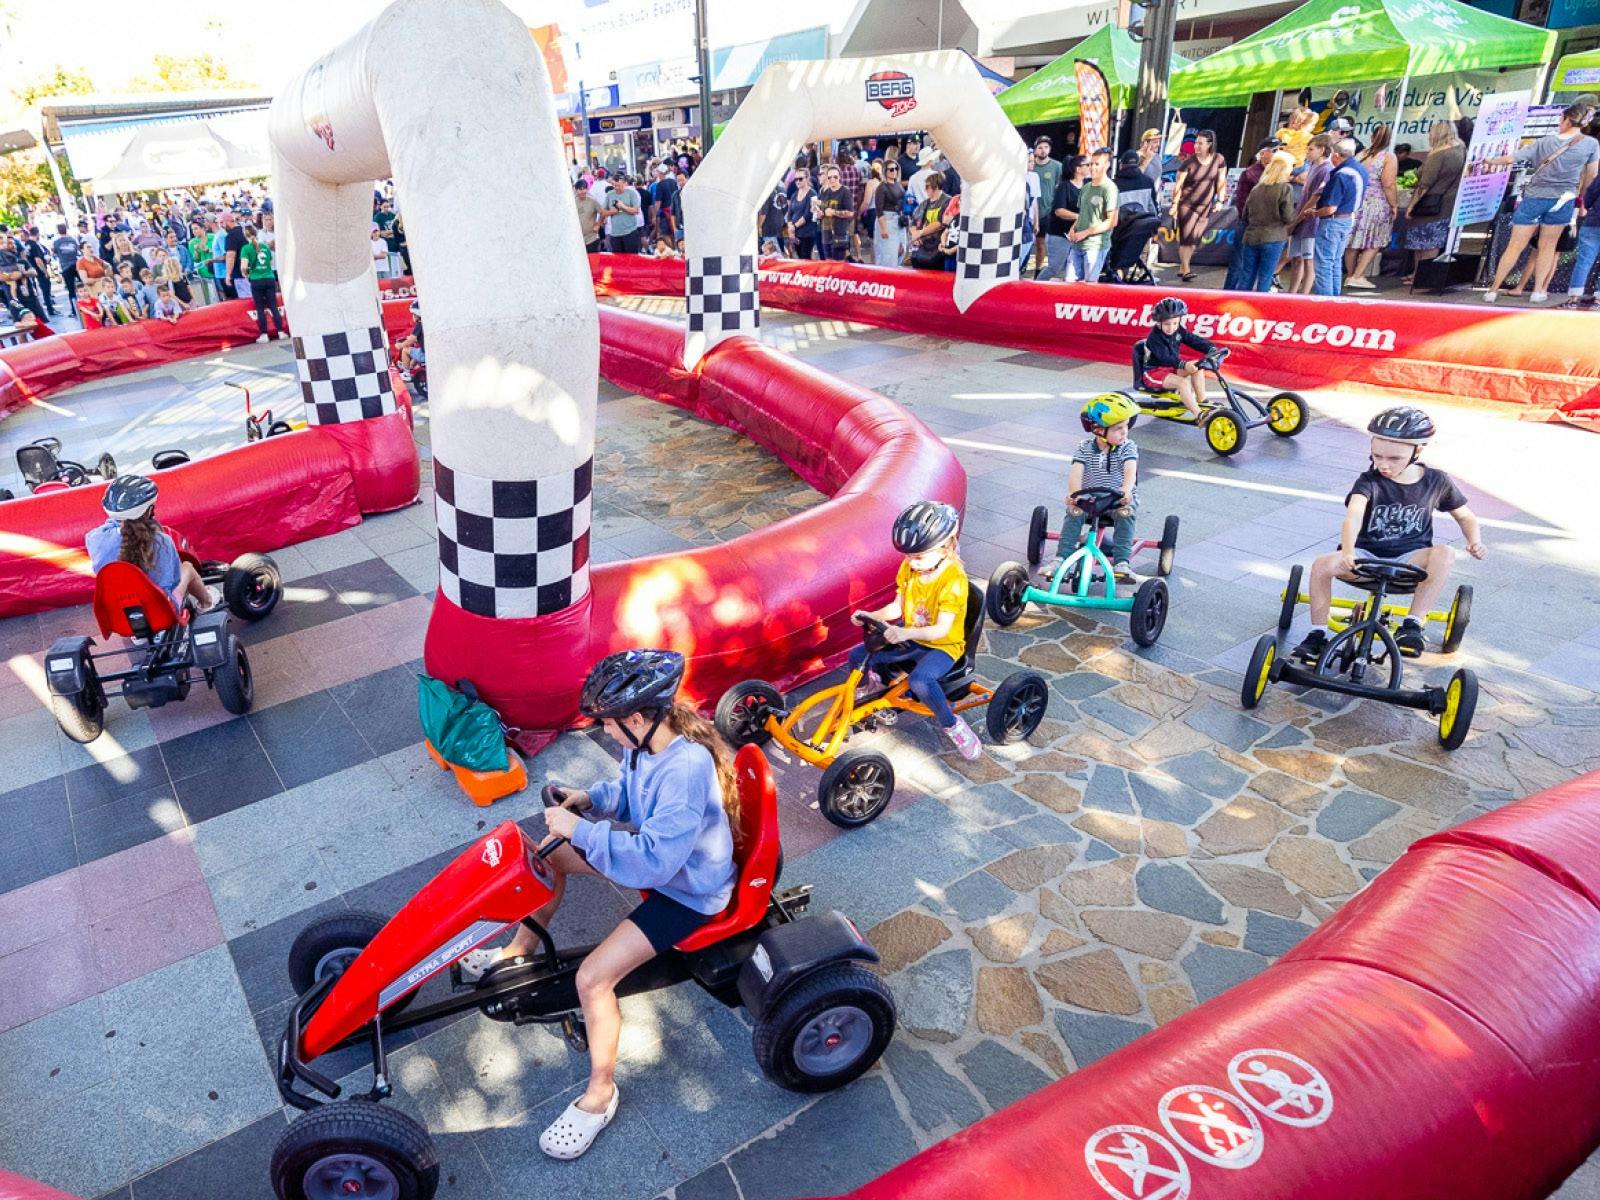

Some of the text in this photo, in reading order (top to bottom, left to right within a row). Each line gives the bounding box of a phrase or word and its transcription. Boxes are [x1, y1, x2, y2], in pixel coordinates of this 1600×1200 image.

[868, 80, 911, 97] BERG
[758, 269, 895, 300] www.bergtoys.com
[1054, 302, 1397, 351] www.brgtoys.com
[408, 934, 474, 983] EXTRA SPORT
